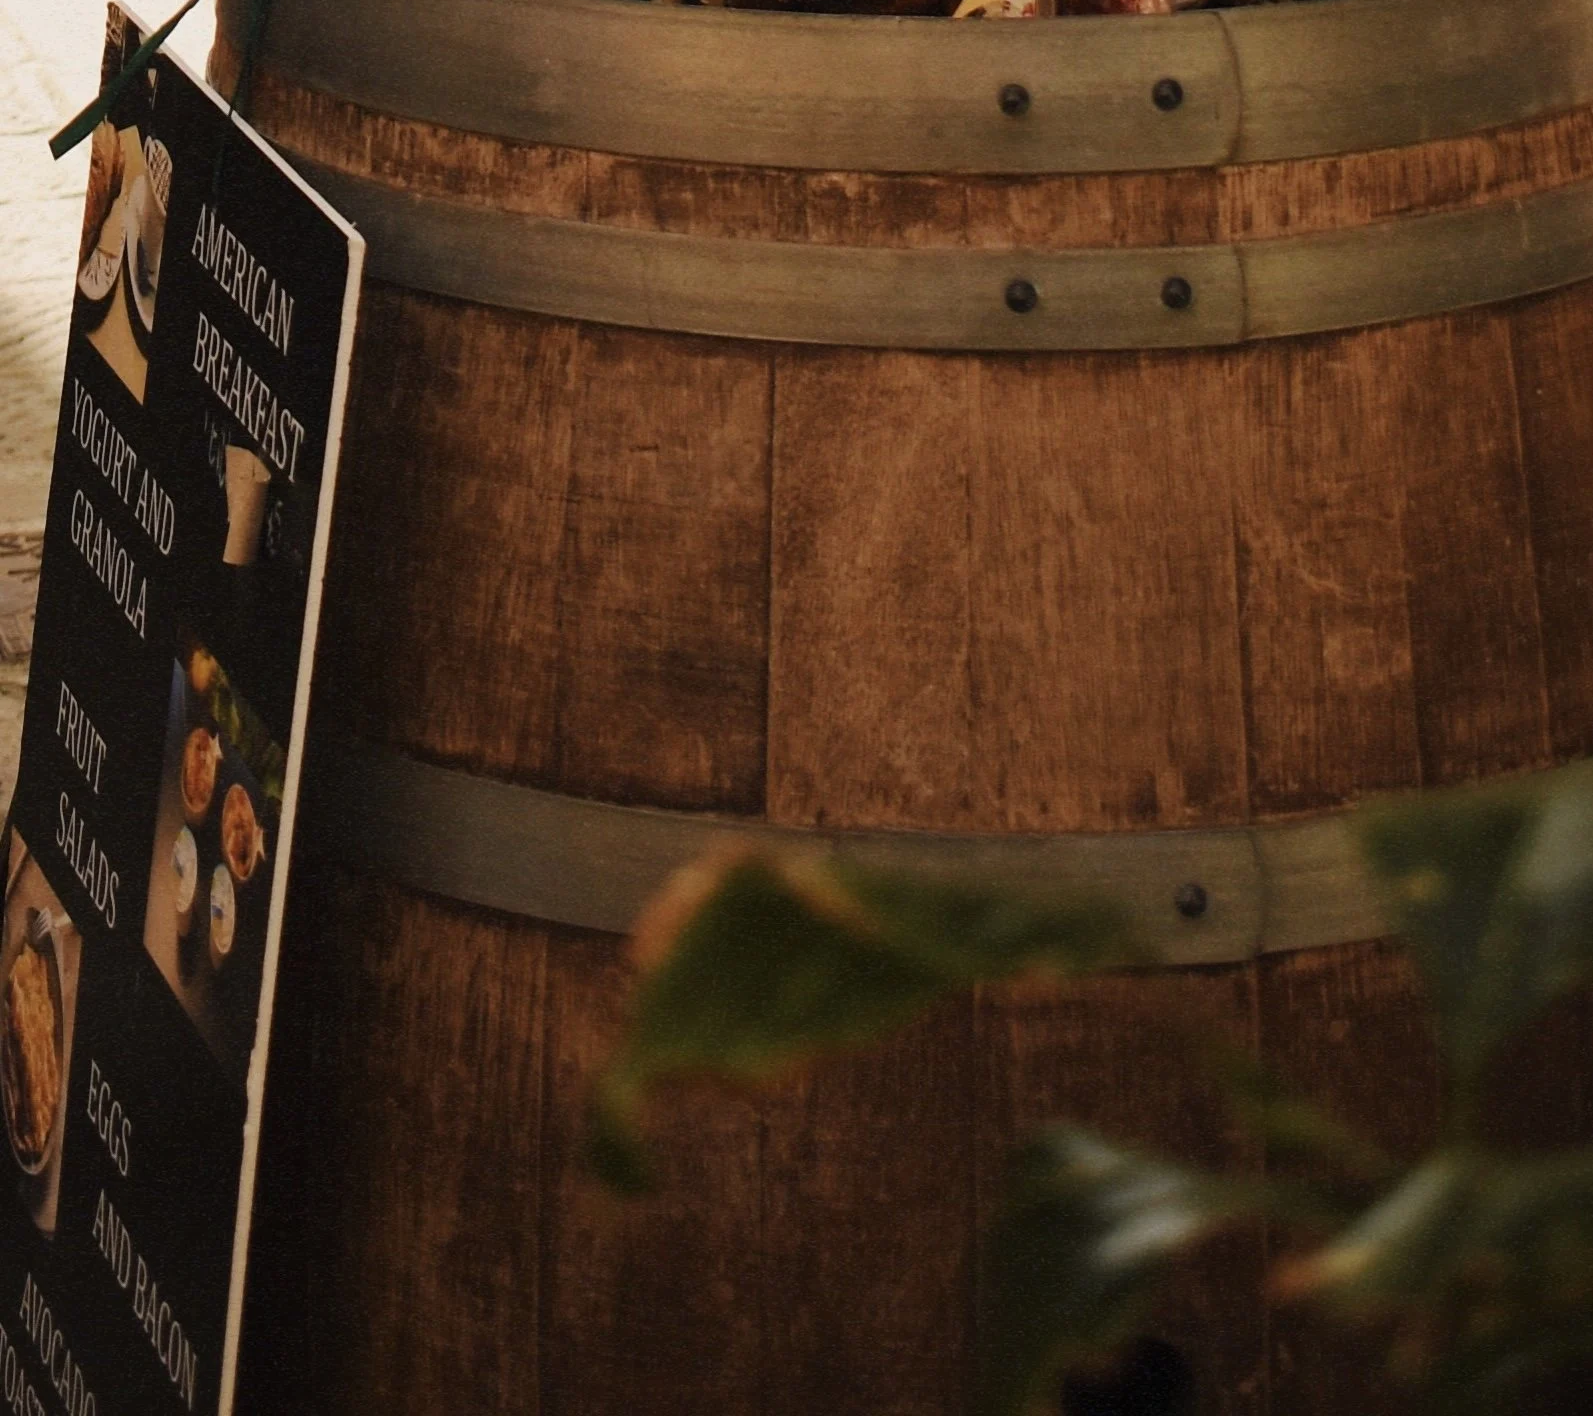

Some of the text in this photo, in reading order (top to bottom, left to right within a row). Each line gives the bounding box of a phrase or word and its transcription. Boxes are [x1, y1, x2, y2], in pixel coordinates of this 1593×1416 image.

[191, 202, 295, 357] AMERICAN
[71, 377, 175, 556] YOGURT AND
[193, 311, 305, 484] BREAKFAST
[70, 489, 147, 641] GRANOLA
[56, 680, 107, 794] FRUIT
[56, 791, 119, 929] SALADS
[87, 1058, 132, 1177] EGGS
[92, 1188, 198, 1412] AND BACON
